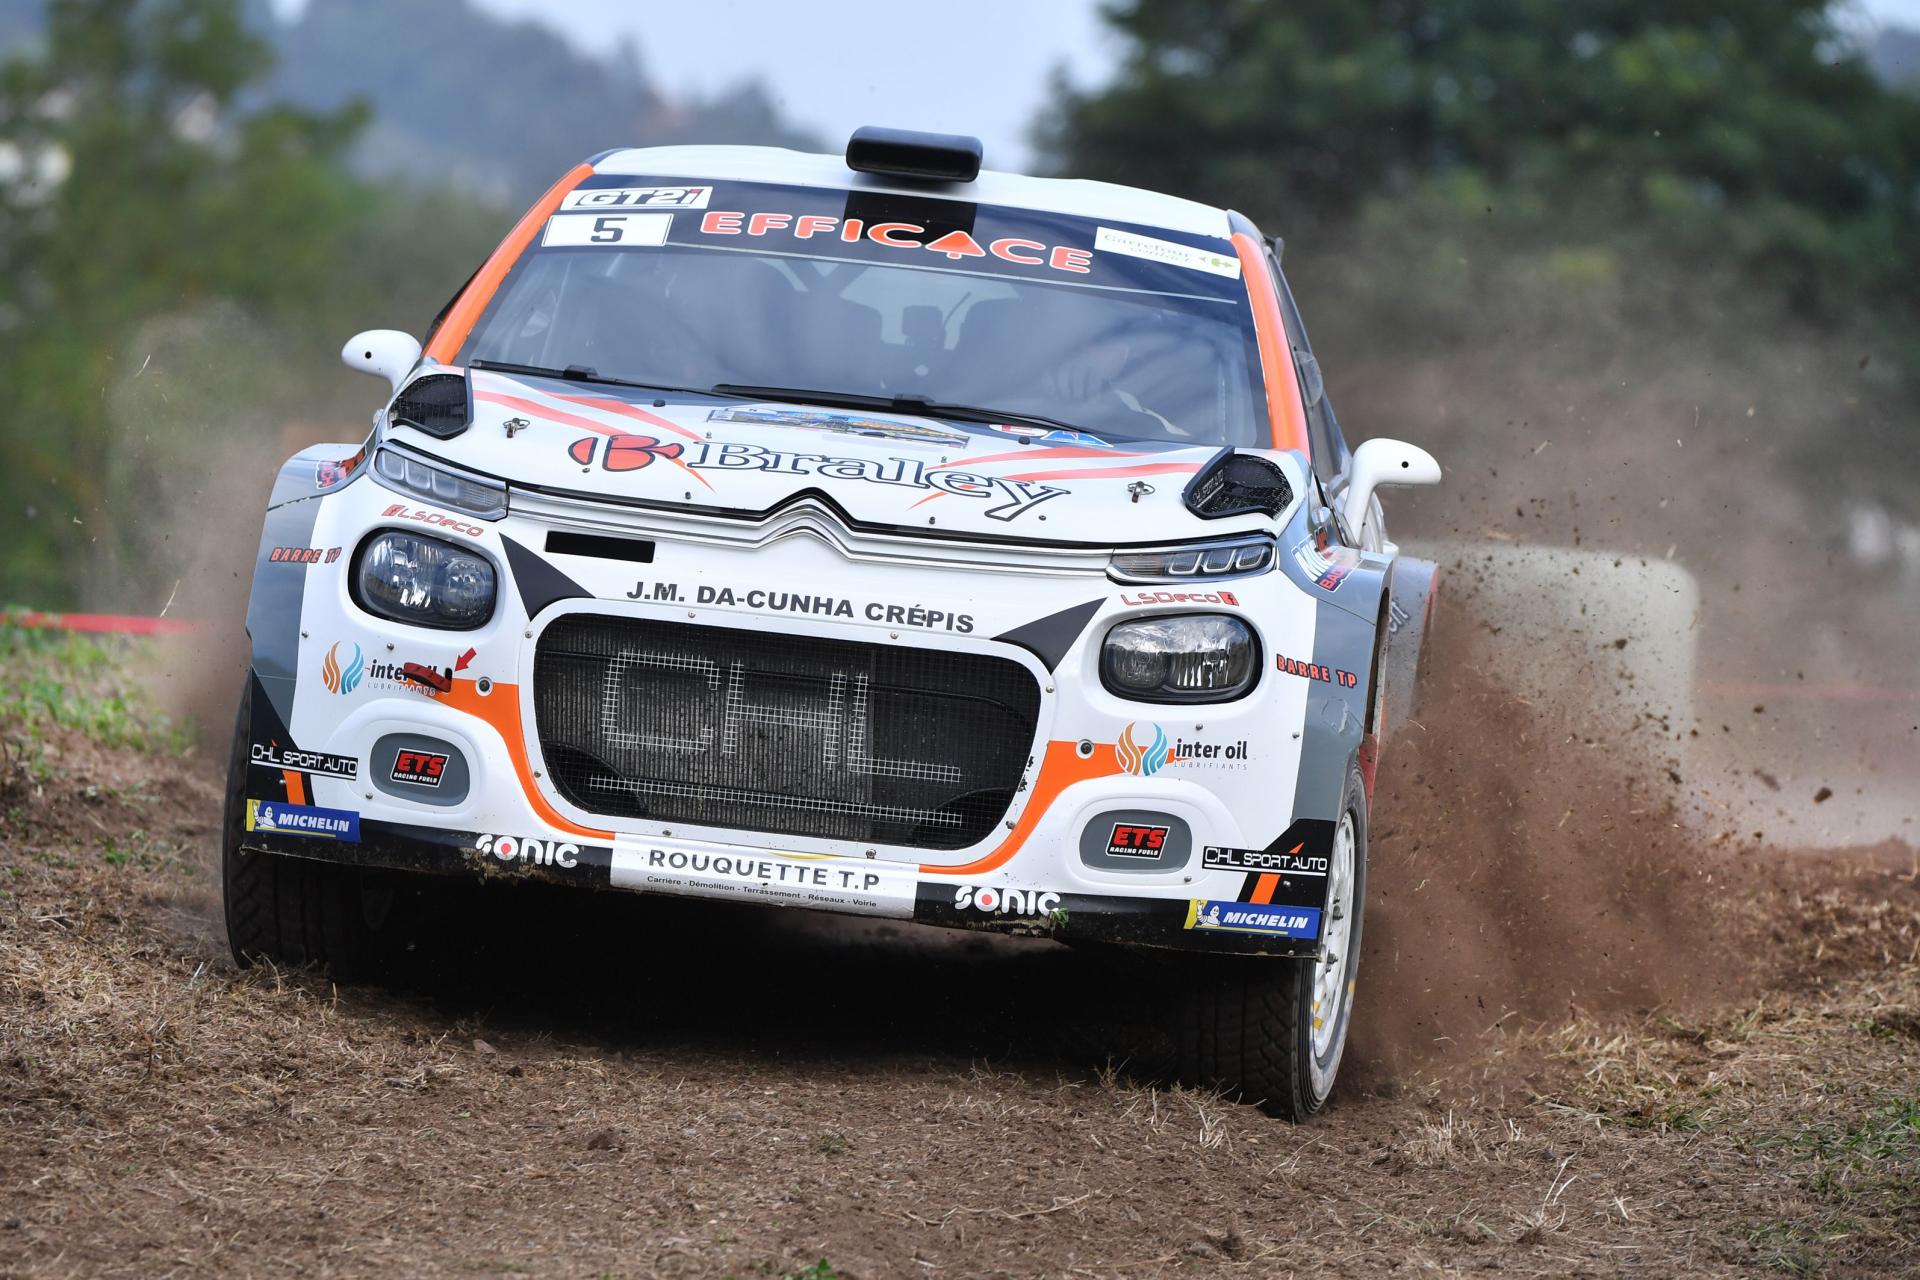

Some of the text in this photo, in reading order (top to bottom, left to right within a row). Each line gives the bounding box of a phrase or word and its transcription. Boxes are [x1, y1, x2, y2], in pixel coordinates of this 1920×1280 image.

[590, 217, 628, 243] 5
[687, 441, 1072, 522] Braley
[269, 546, 342, 564] BARRE TP
[626, 581, 975, 634] J.M. DA-CUNHA CRÉPIS
[1276, 653, 1358, 689] BARRE TP
[251, 744, 358, 774] CHL SPORT AUTO
[1176, 738, 1248, 760] inter oil
[397, 753, 445, 776] ETS
[1174, 761, 1248, 771] LUBRIFIANTS
[393, 772, 417, 781] RACING
[278, 813, 350, 833] MICHELIN
[1113, 827, 1165, 849] ETS
[1109, 846, 1159, 856] RACING FUELS
[1204, 847, 1328, 872] CHL SPORT AUTO
[648, 849, 880, 891] ROUQUETTE T.P
[647, 875, 681, 886] Carrière
[689, 880, 735, 892] Démolition
[743, 886, 801, 900] Terrassement
[808, 894, 845, 905] Réseaux
[852, 899, 877, 908] Voirie
[1222, 911, 1309, 929] MICHELIN
